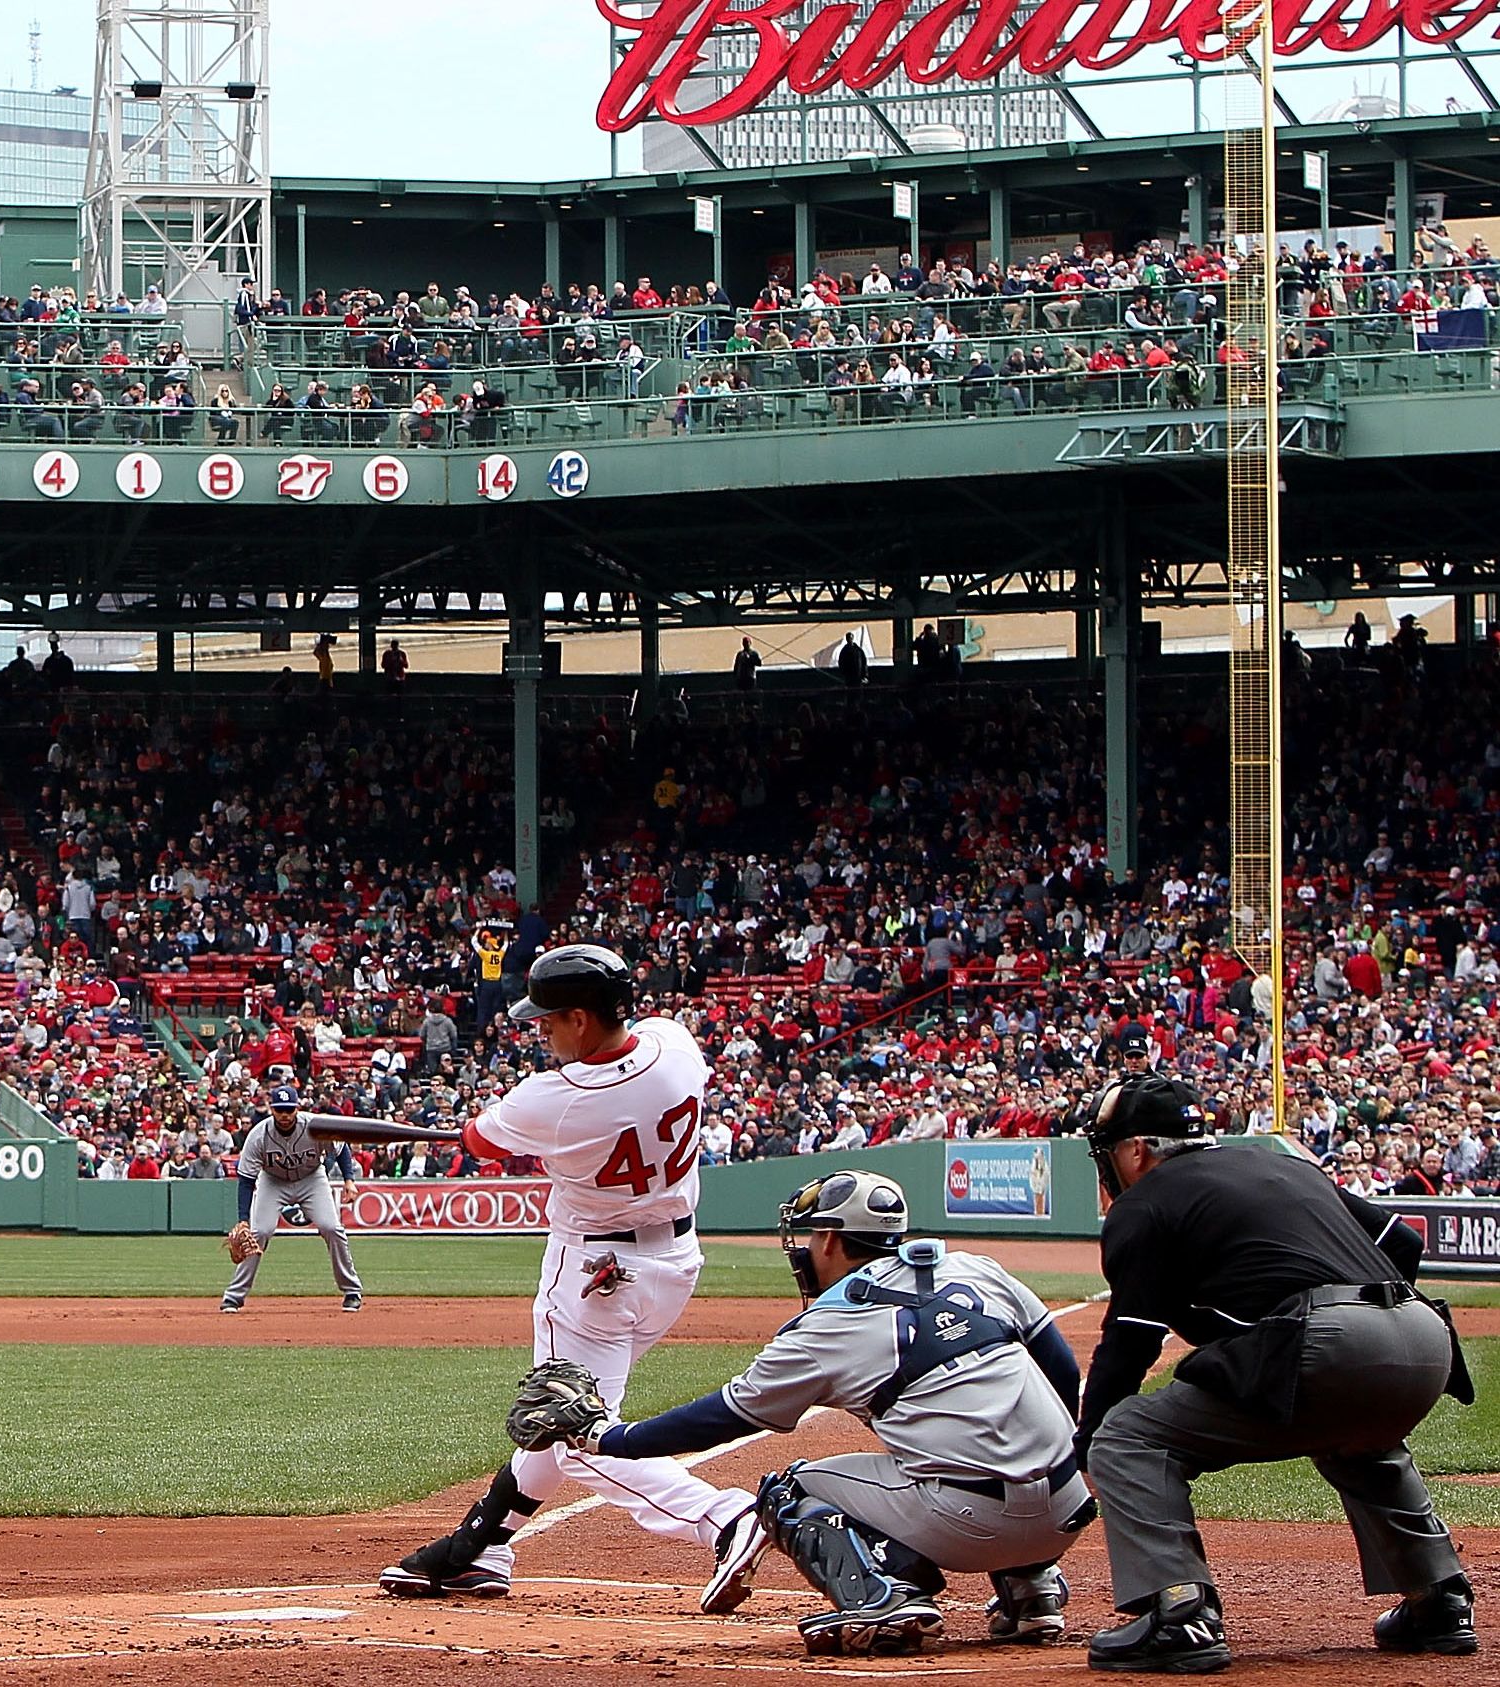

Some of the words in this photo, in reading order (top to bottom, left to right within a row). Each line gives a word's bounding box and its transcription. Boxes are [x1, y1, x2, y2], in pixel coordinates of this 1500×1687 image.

[43, 458, 65, 492] 4
[134, 460, 145, 493] 1
[209, 461, 233, 494] 8
[280, 461, 333, 496] 27
[375, 463, 398, 496] 6
[478, 460, 513, 495] 14
[548, 457, 583, 491] 42
[595, 1096, 697, 1195] 42
[950, 1170, 967, 1189] Hood
[1183, 1620, 1214, 1643] N
